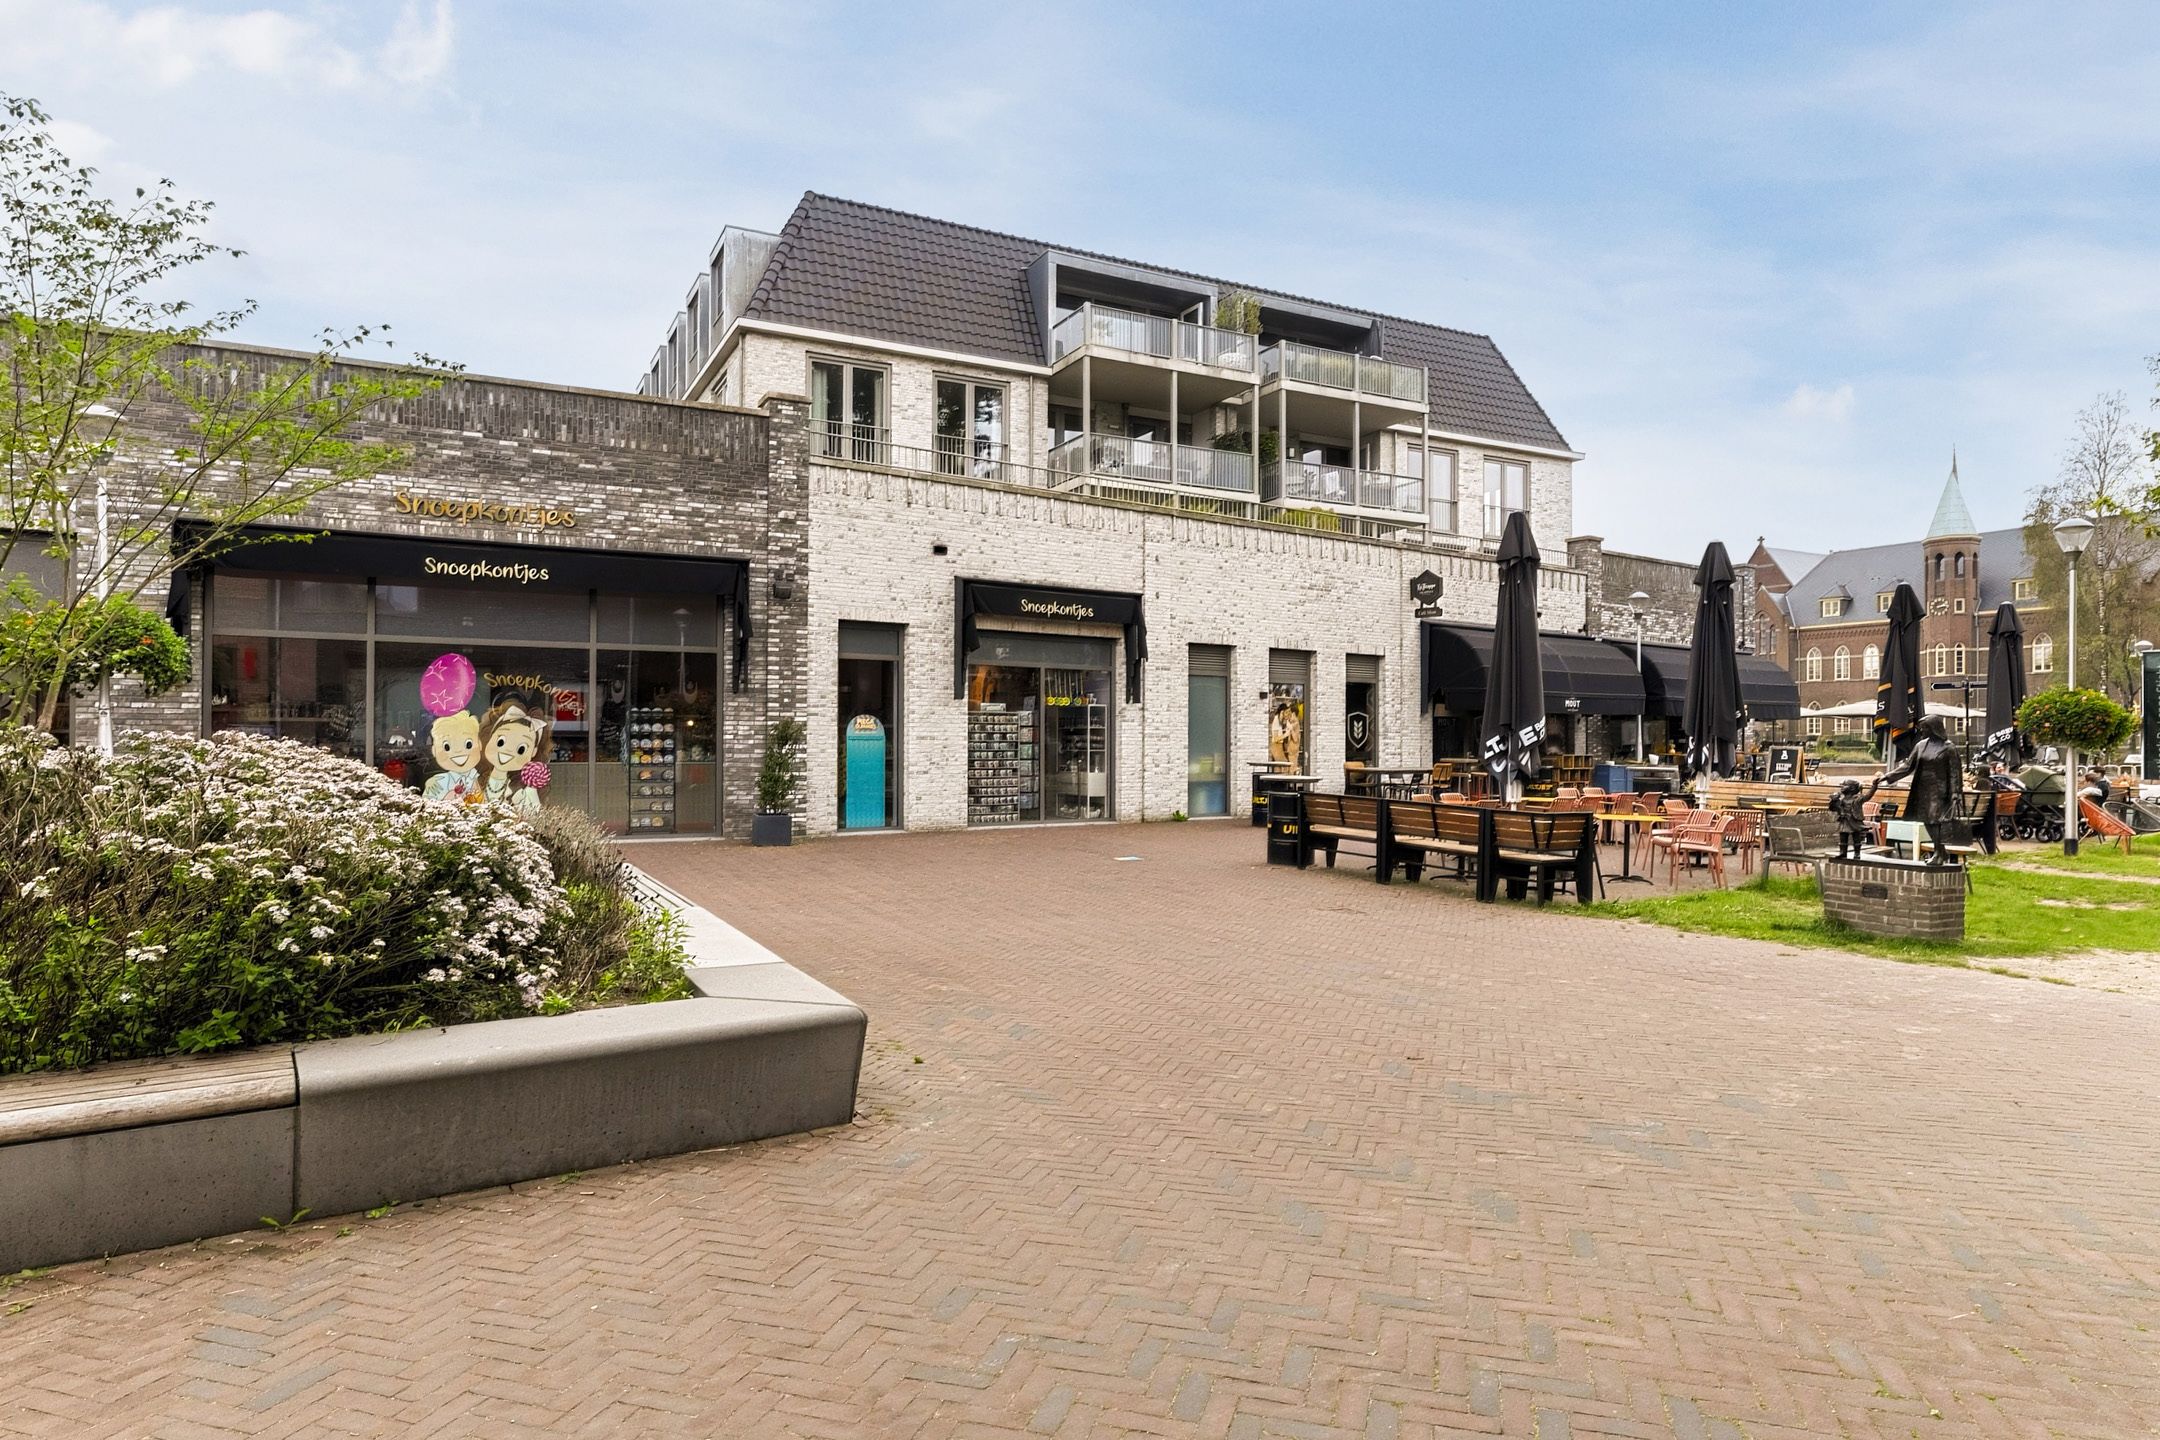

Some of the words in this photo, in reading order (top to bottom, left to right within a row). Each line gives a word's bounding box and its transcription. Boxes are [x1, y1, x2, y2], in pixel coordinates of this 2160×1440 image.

[394, 489, 577, 532] Snoepkontjes
[424, 557, 550, 585] Snoepkontjes
[1020, 598, 1095, 621] Snoepkontjes
[483, 672, 585, 716] Snoepkontjes
[1564, 699, 1581, 708] MOUT
